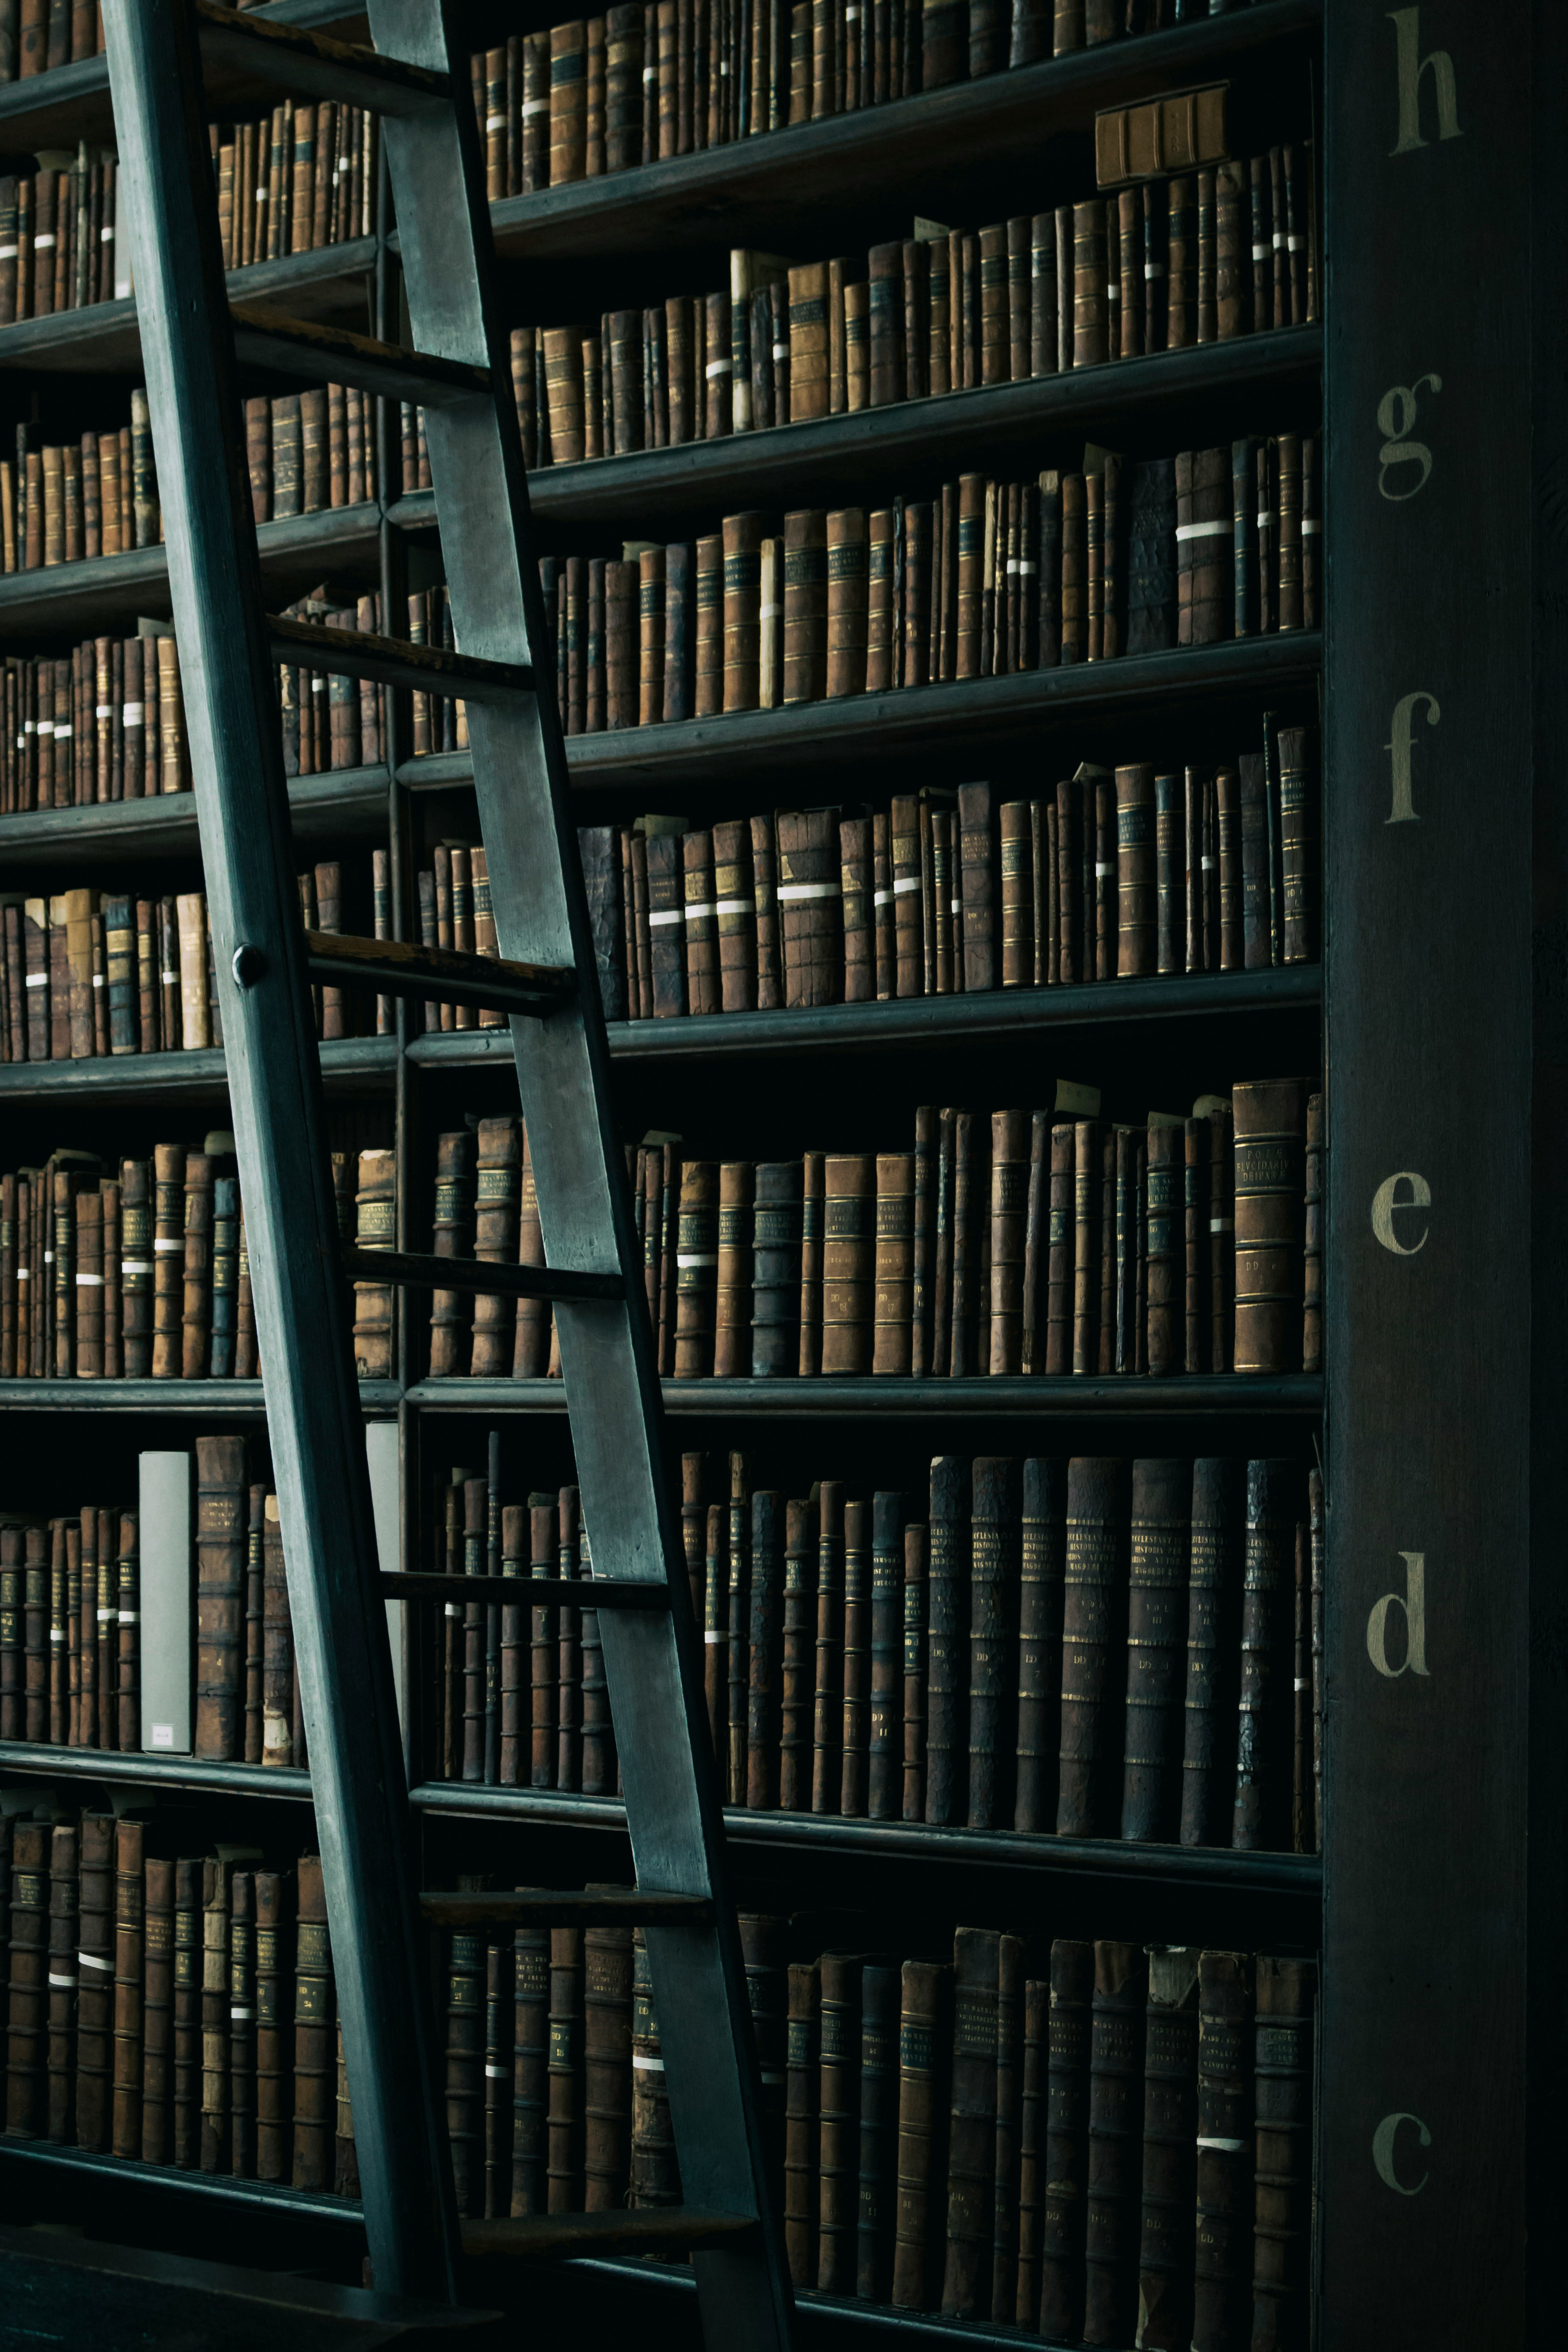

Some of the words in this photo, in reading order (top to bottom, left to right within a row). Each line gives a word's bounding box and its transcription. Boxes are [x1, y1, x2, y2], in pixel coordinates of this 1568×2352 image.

[1386, 7, 1462, 156] h
[1377, 374, 1441, 501] g
[1384, 692, 1440, 824] f
[1371, 1172, 1430, 1255] e
[1367, 1552, 1429, 1677] d
[1372, 2113, 1431, 2195] c
[868, 2207, 877, 2216] 11
[1213, 2252, 1218, 2261] 3
